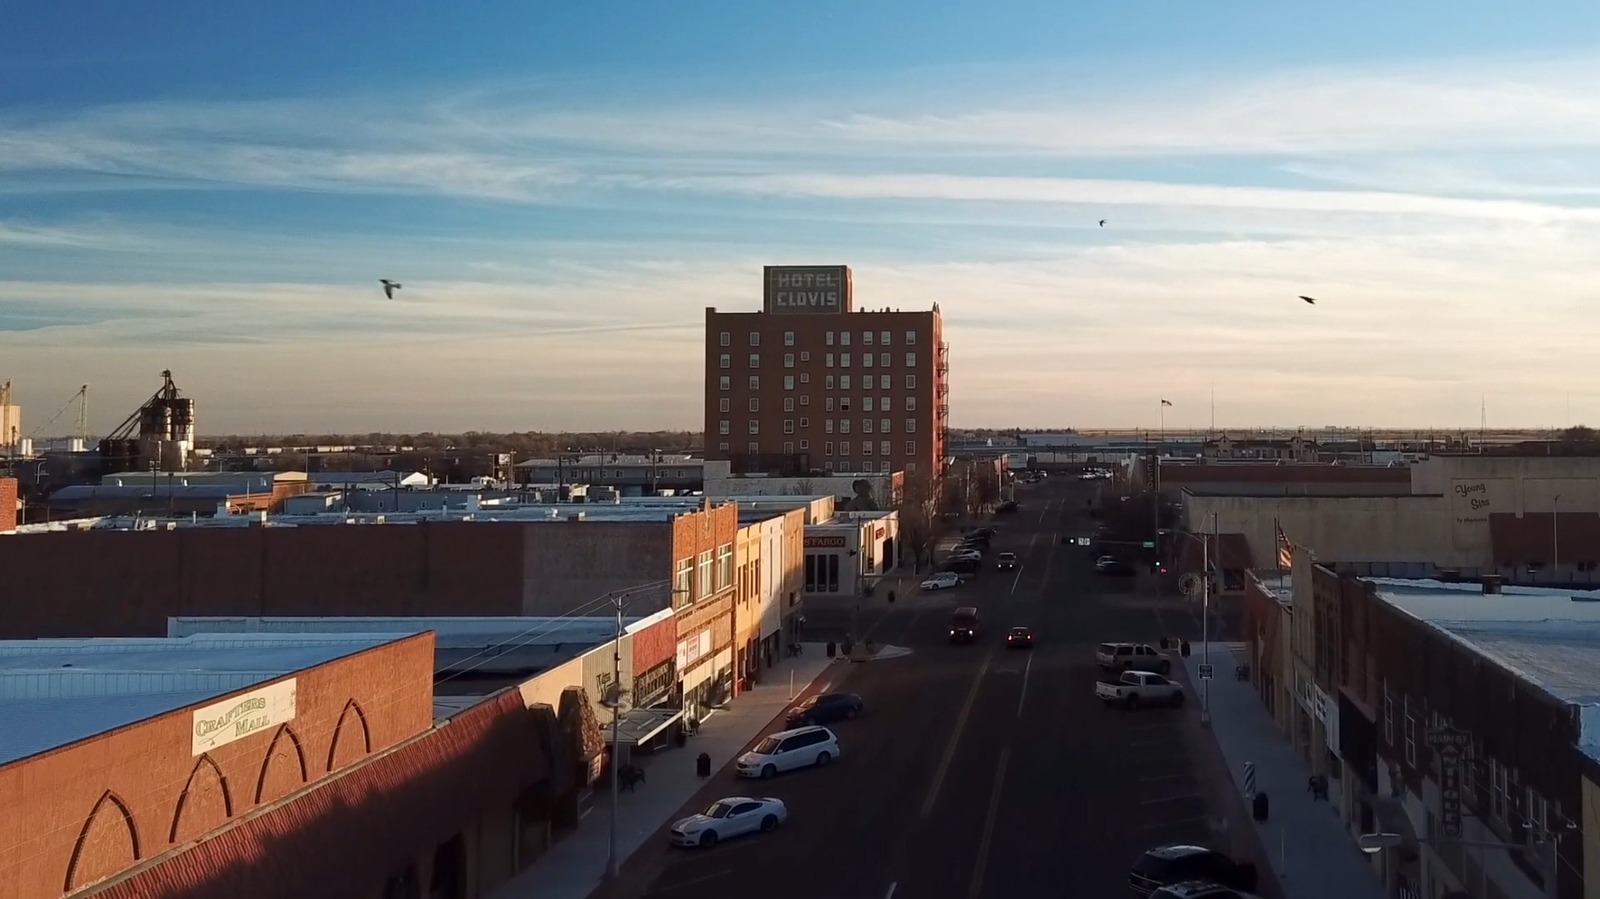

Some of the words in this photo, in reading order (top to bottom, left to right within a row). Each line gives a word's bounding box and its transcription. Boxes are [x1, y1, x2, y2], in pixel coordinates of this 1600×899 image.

[778, 273, 836, 288] HOTEL
[777, 291, 837, 306] CLOVIS
[1455, 483, 1486, 498] Young
[811, 538, 844, 546] FARGO
[195, 697, 266, 737] CRAFTERS
[235, 715, 270, 737] MALL
